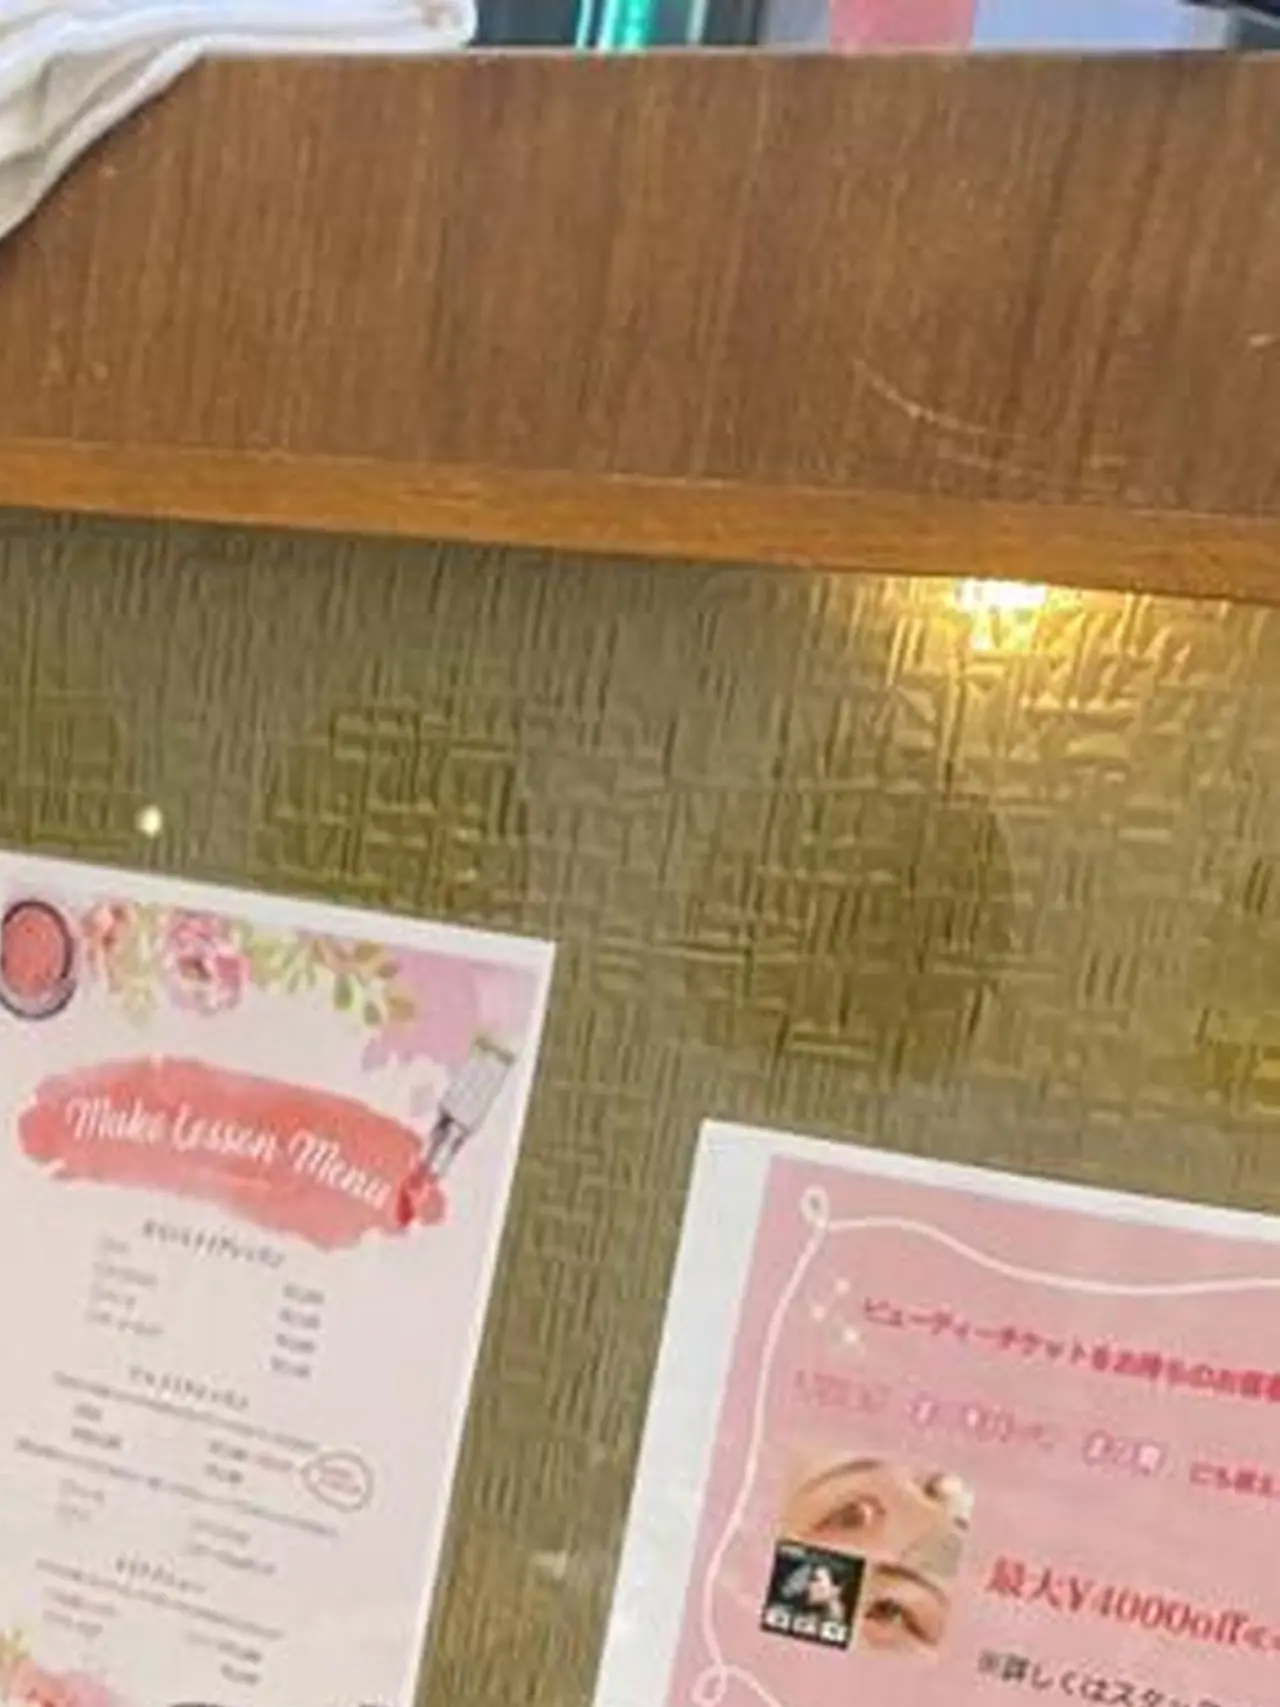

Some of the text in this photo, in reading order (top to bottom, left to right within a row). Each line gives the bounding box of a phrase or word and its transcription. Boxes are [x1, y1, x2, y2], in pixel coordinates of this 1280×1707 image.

[65, 1096, 393, 1209] Make Lesson Menu
